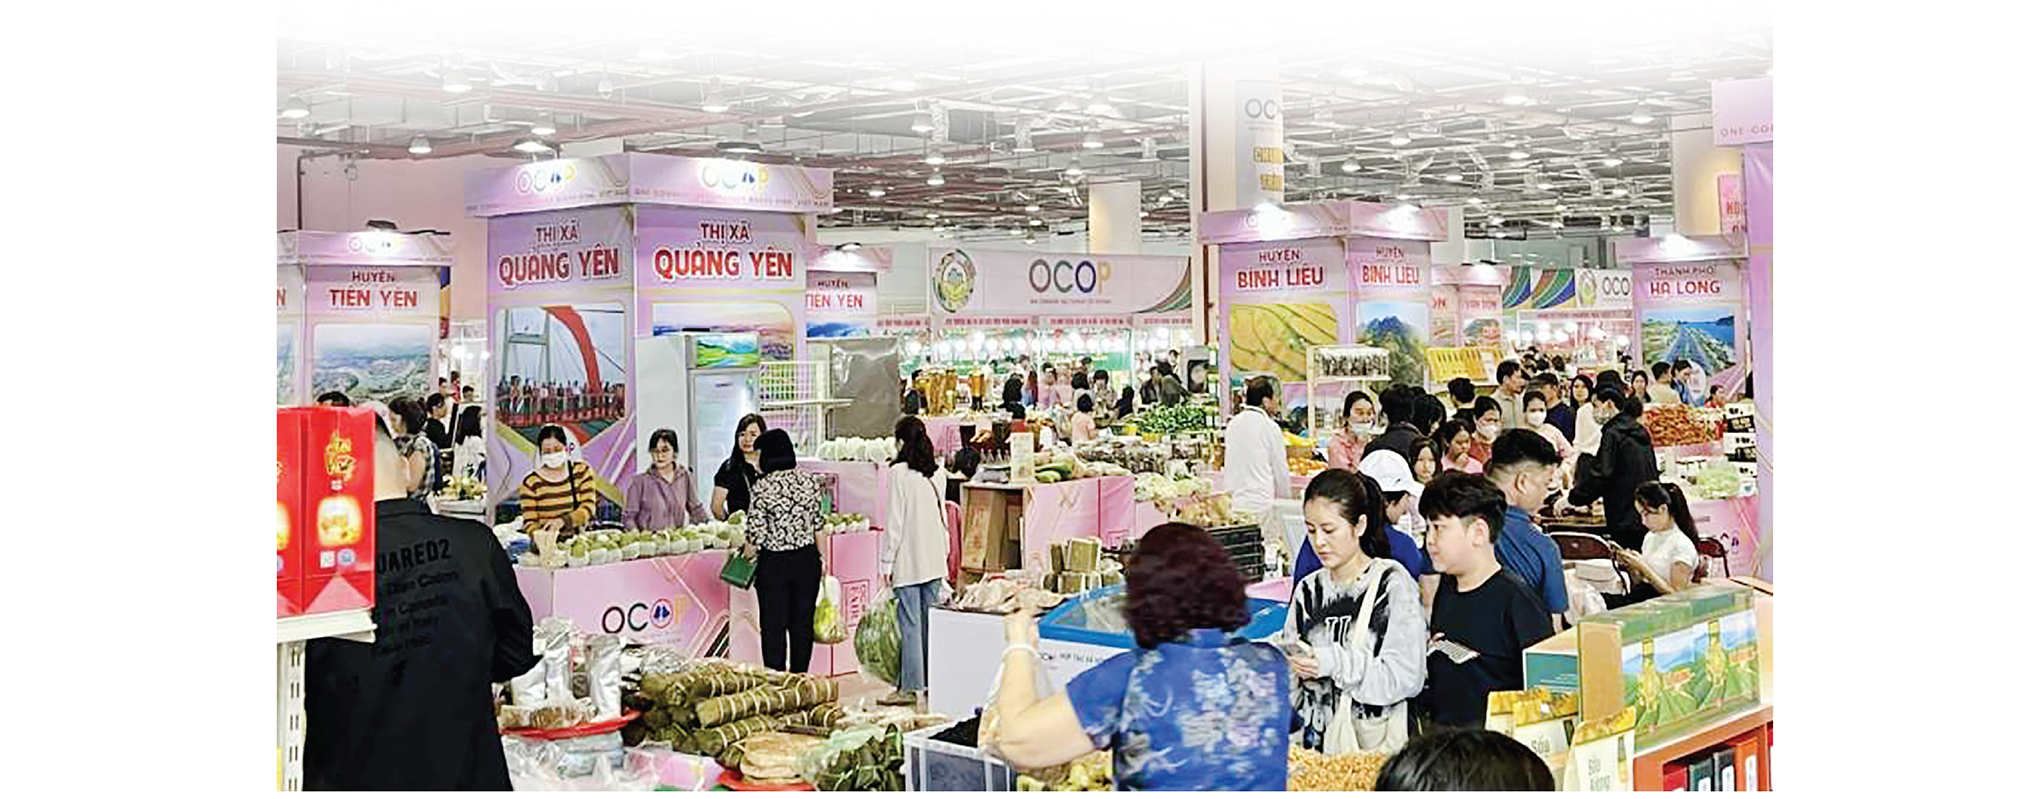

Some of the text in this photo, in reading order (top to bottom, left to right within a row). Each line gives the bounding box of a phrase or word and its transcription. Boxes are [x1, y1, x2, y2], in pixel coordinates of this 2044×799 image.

[516, 165, 576, 194] OCP
[702, 164, 770, 189] OCP
[701, 219, 750, 245] THỊ XÃ
[578, 243, 619, 277] YÊN
[749, 247, 793, 277] YÊN
[1029, 259, 1112, 295] OCOP
[1676, 280, 1721, 295] LONG
